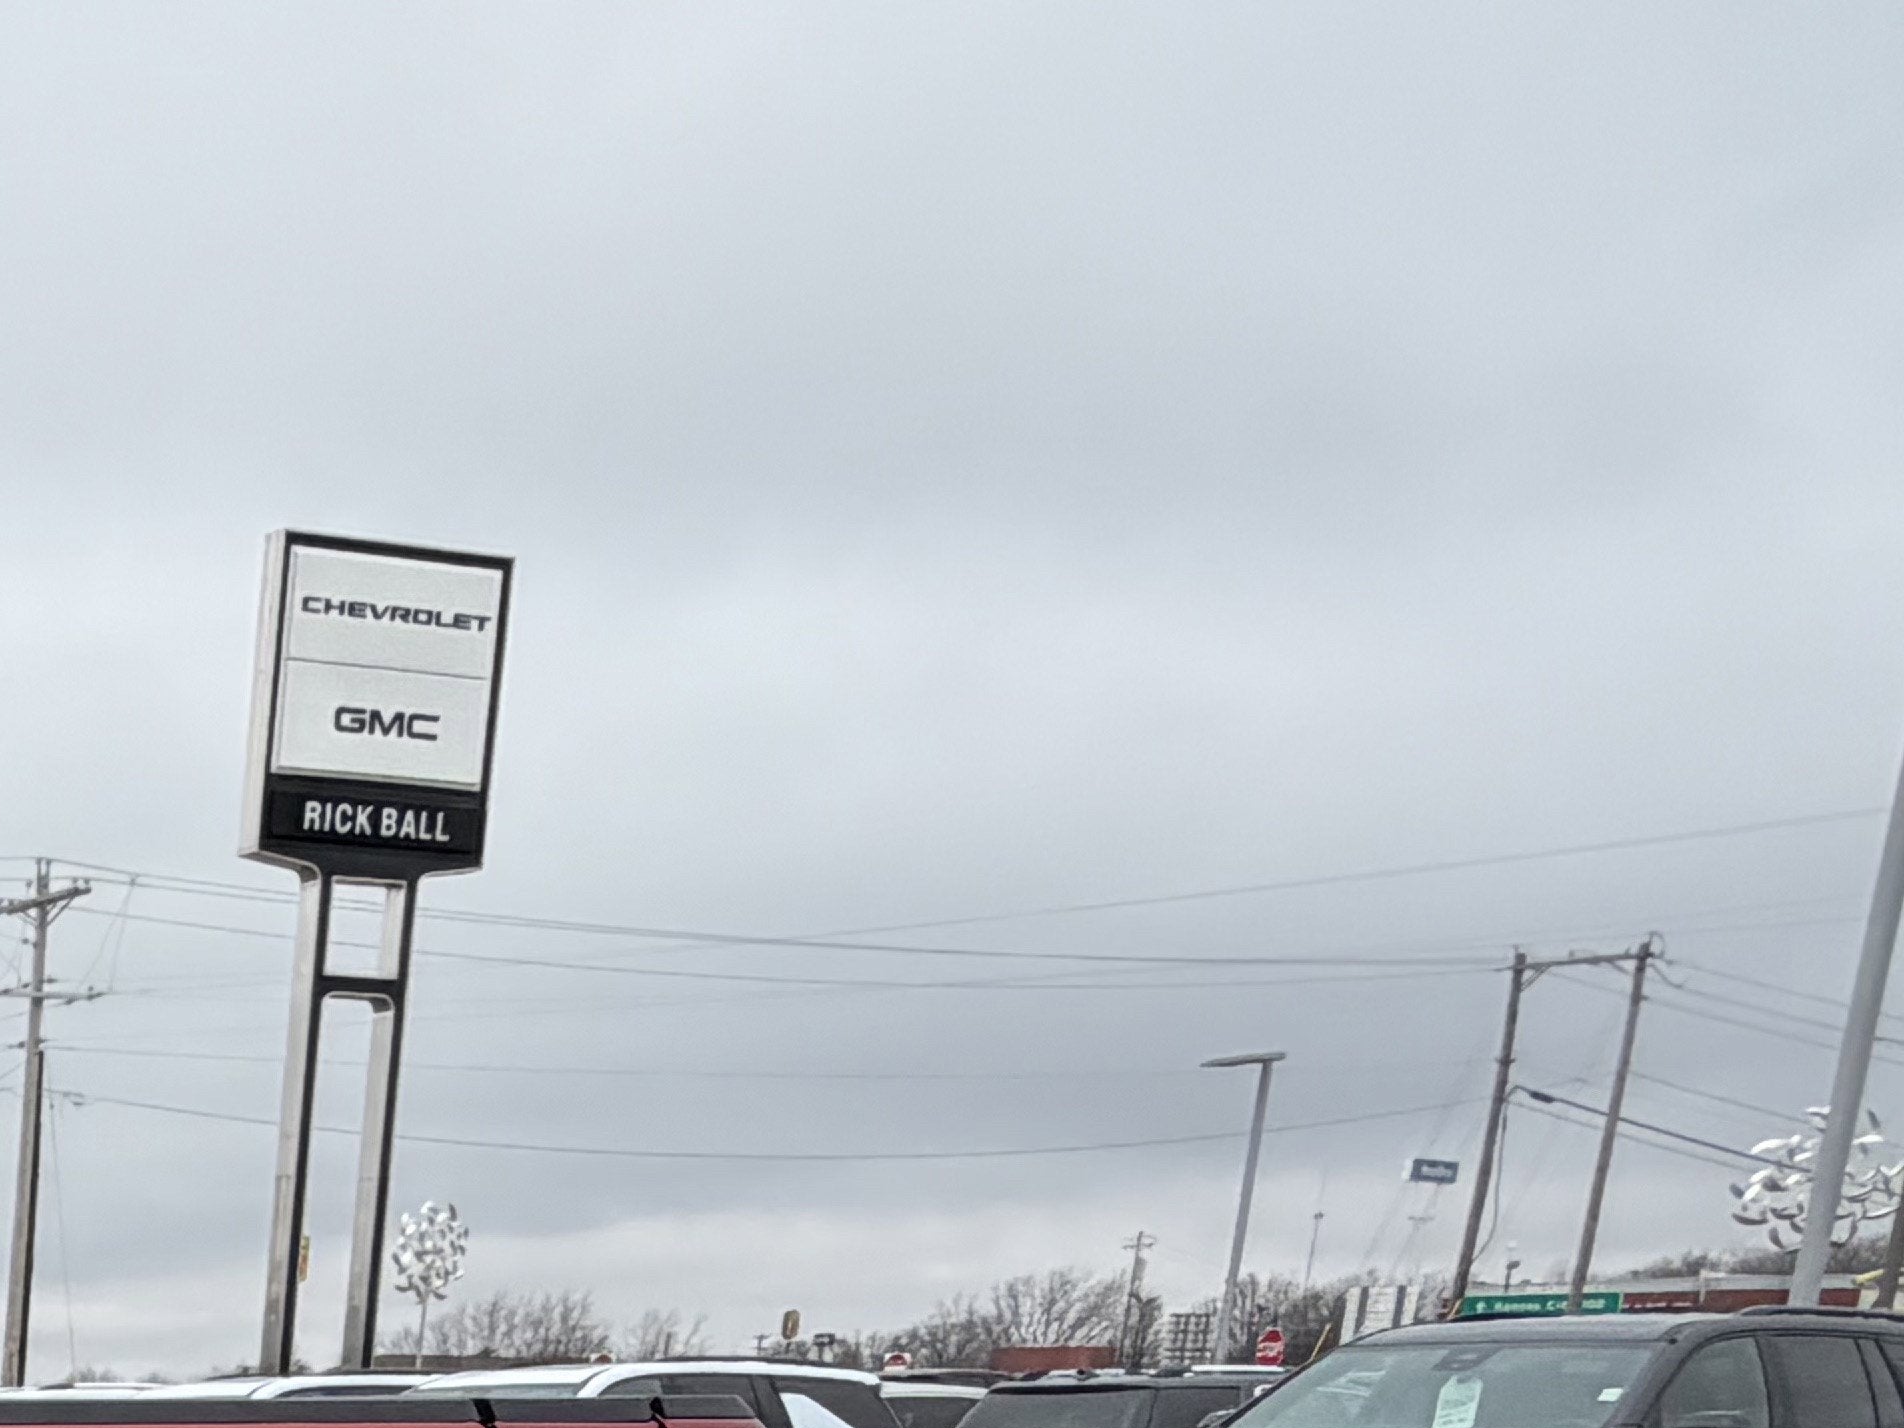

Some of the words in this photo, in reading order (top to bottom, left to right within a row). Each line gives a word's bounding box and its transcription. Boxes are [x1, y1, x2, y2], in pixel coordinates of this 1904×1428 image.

[301, 595, 492, 632] CHEVROLET
[333, 706, 441, 741] GMC
[303, 800, 374, 836] RICK
[380, 807, 450, 842] BALL
